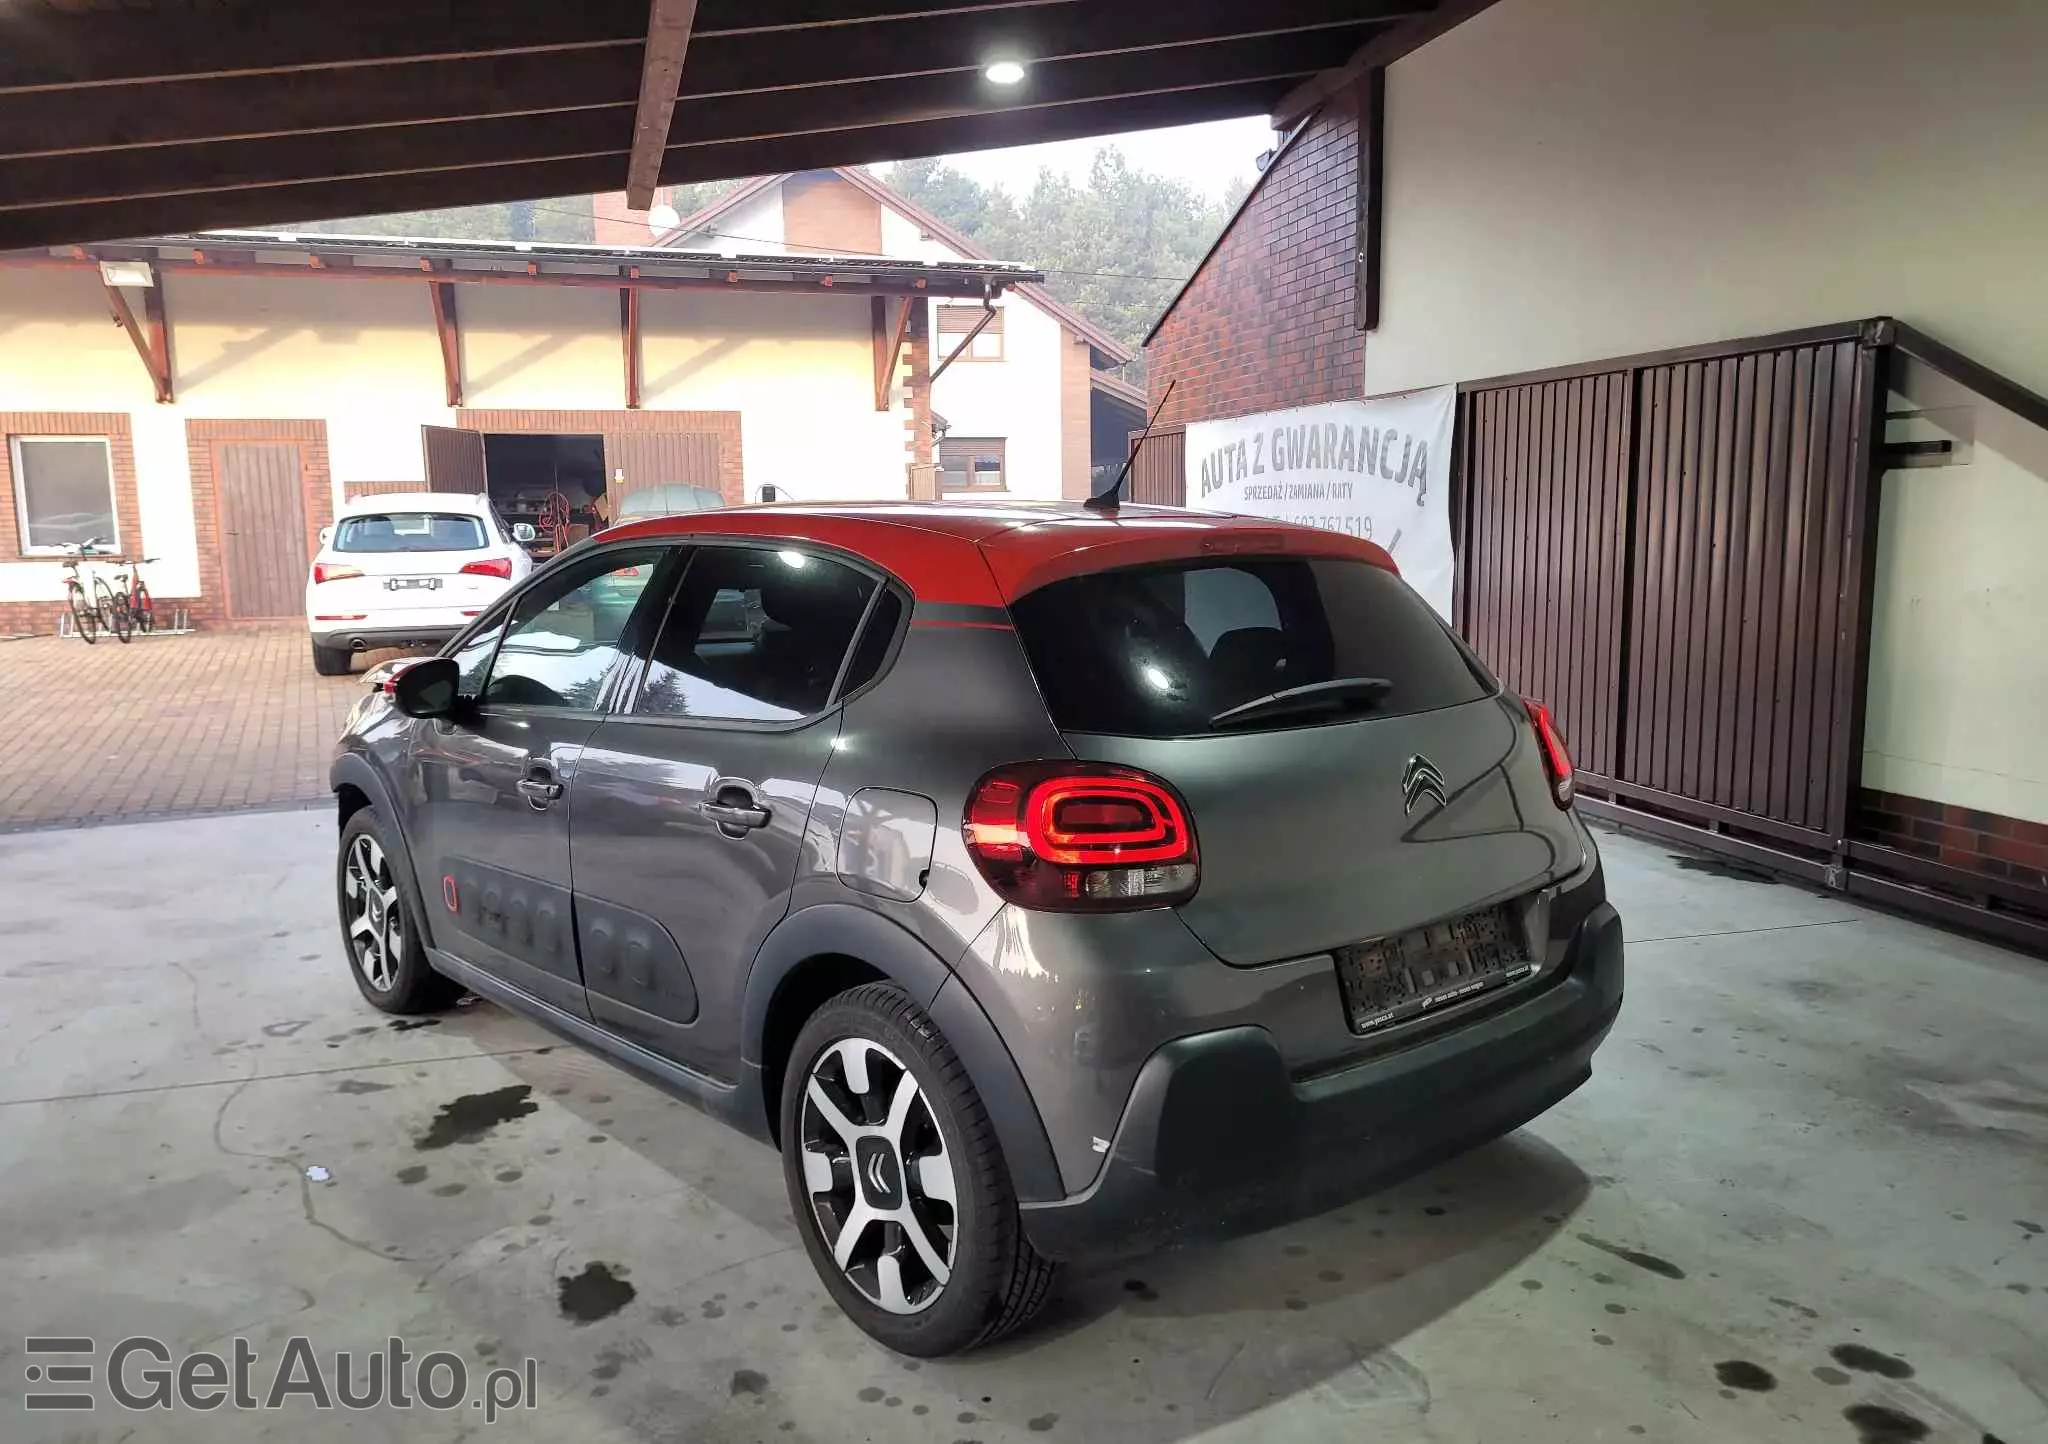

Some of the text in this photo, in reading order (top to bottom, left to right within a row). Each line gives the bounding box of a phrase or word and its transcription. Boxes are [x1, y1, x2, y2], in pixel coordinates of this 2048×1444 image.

[1201, 422, 1429, 507] AUTA Z GWARANCJĄ
[1345, 515, 1373, 541] 519
